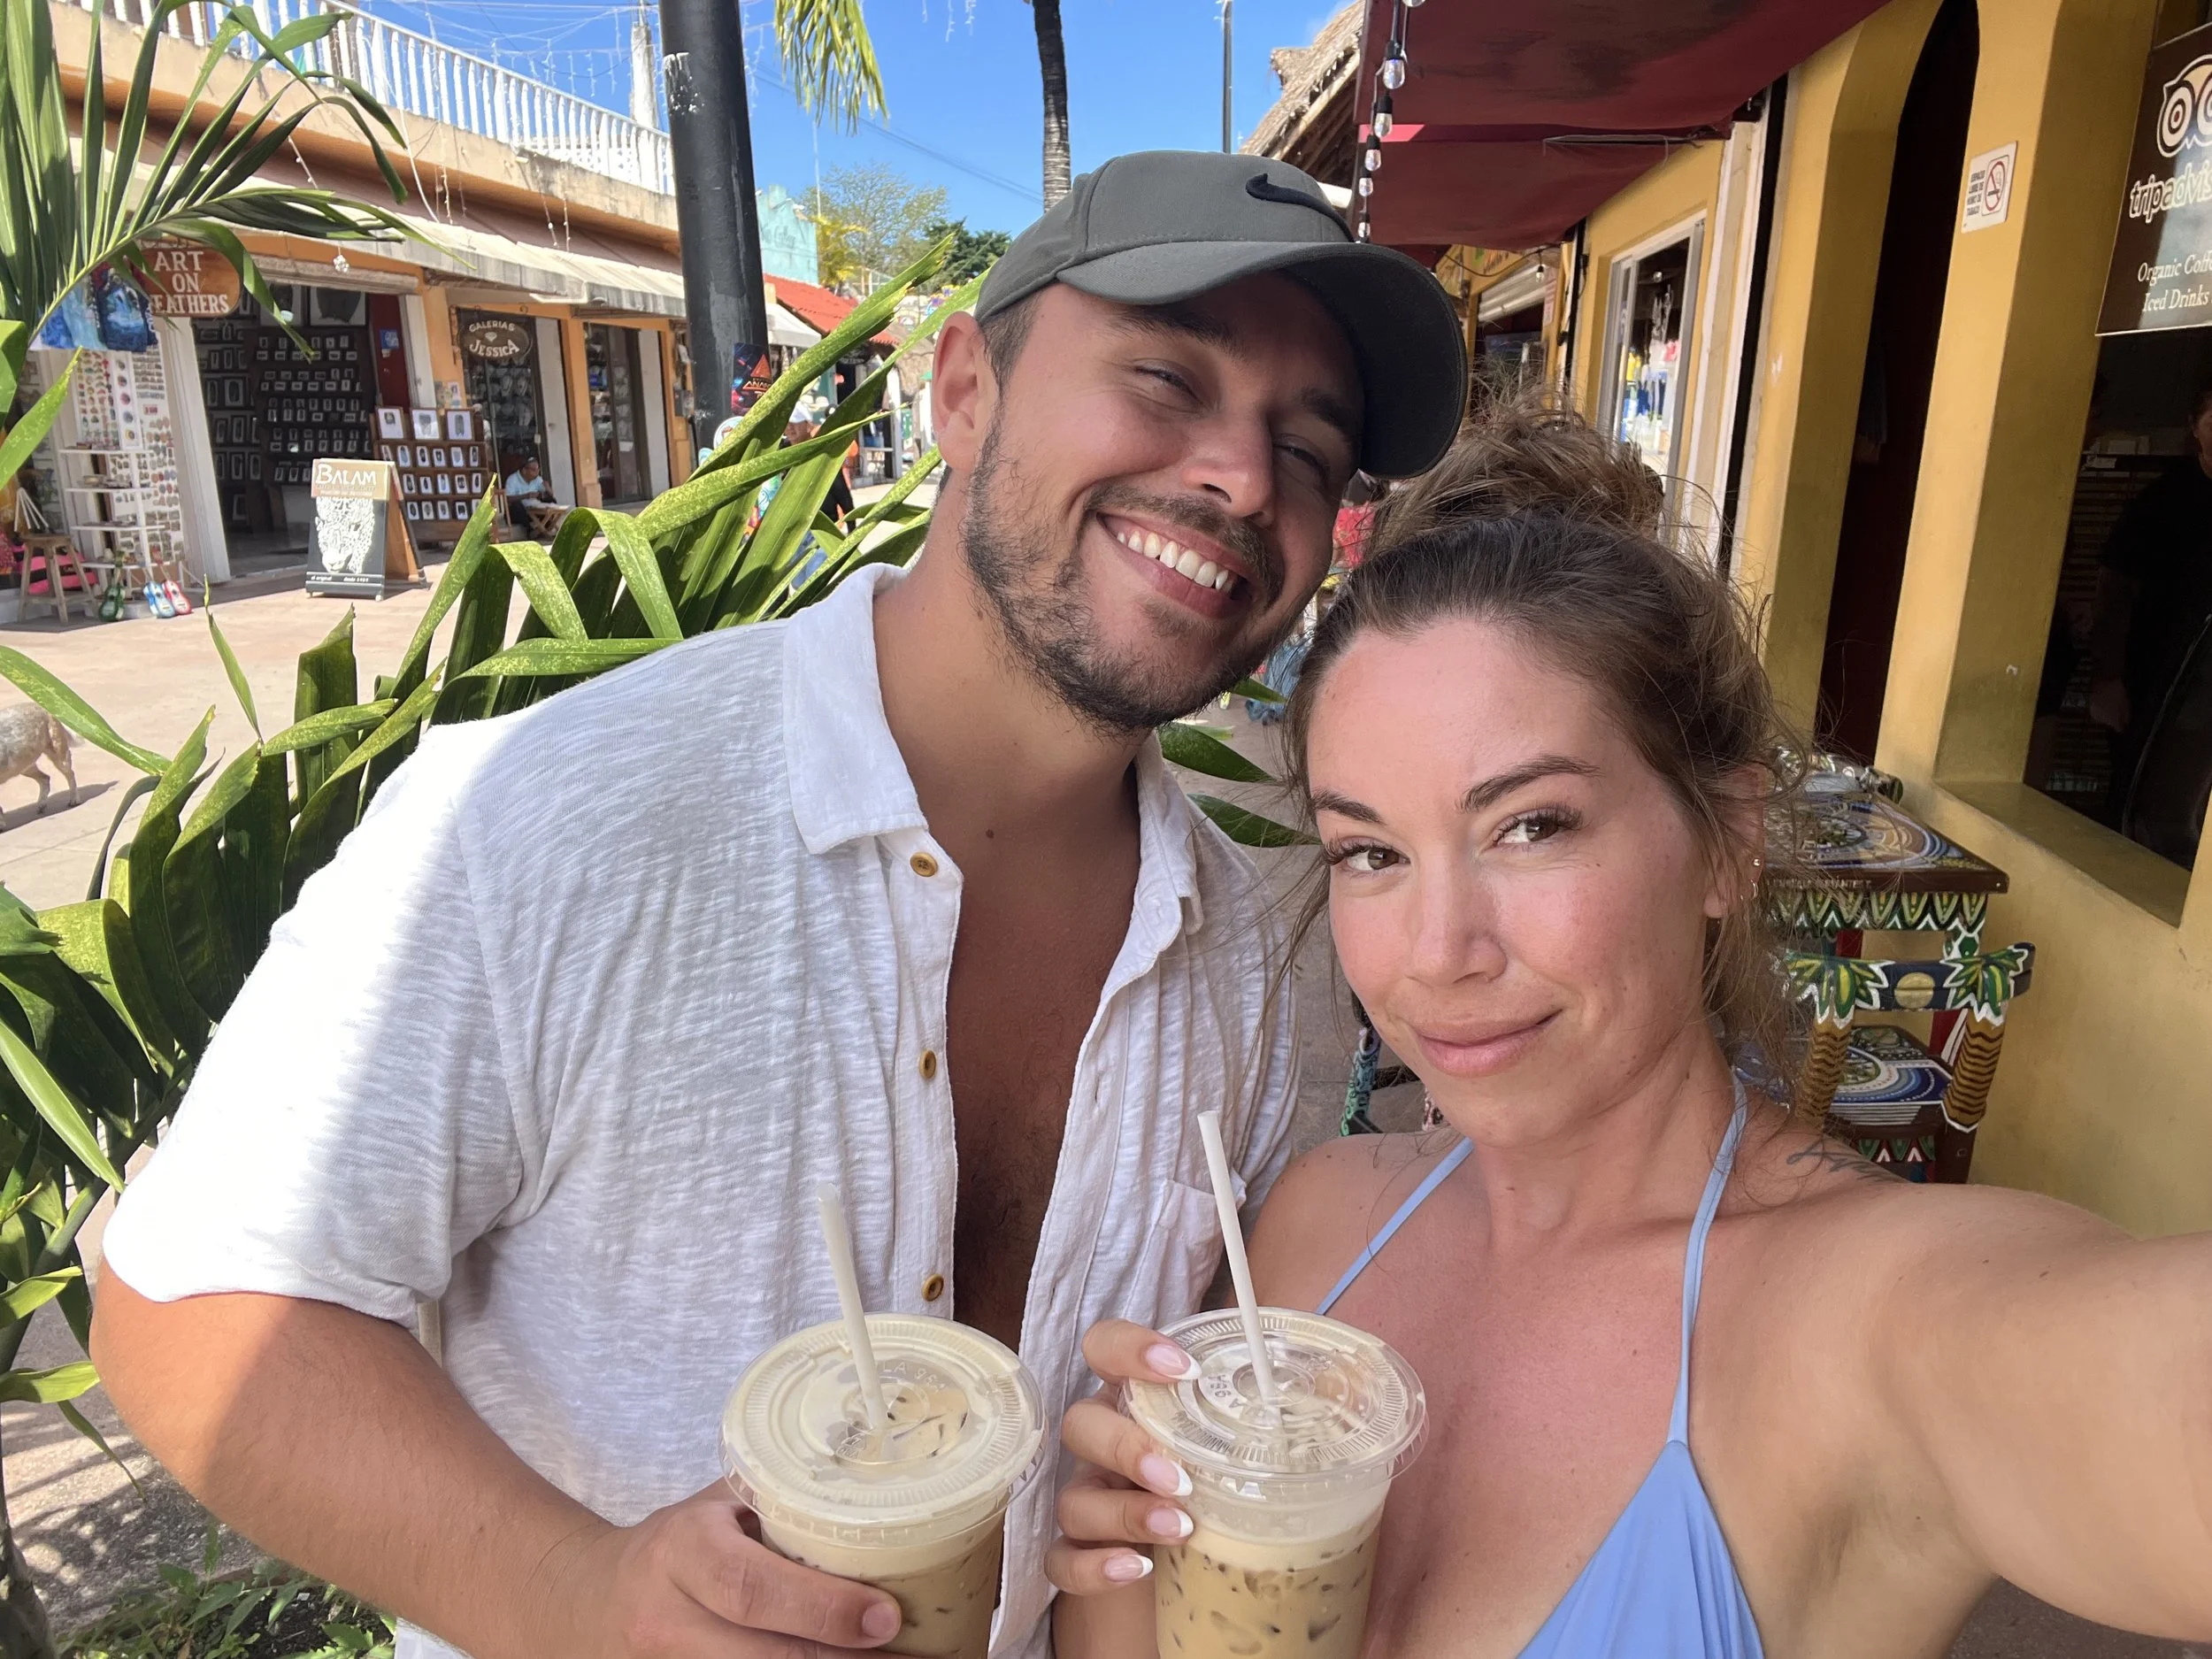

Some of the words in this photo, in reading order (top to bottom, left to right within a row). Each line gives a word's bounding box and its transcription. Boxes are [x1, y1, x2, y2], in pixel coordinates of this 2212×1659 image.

[153, 250, 204, 272] ART
[2138, 258, 2182, 287] Organic
[171, 273, 200, 293] ON
[149, 294, 230, 314] EATHERS
[2142, 289, 2168, 311] Iced
[2168, 283, 2210, 310] Drinks
[469, 319, 516, 333] GALERIAS
[469, 339, 520, 357] JESSICA
[316, 464, 376, 485] BALAM
